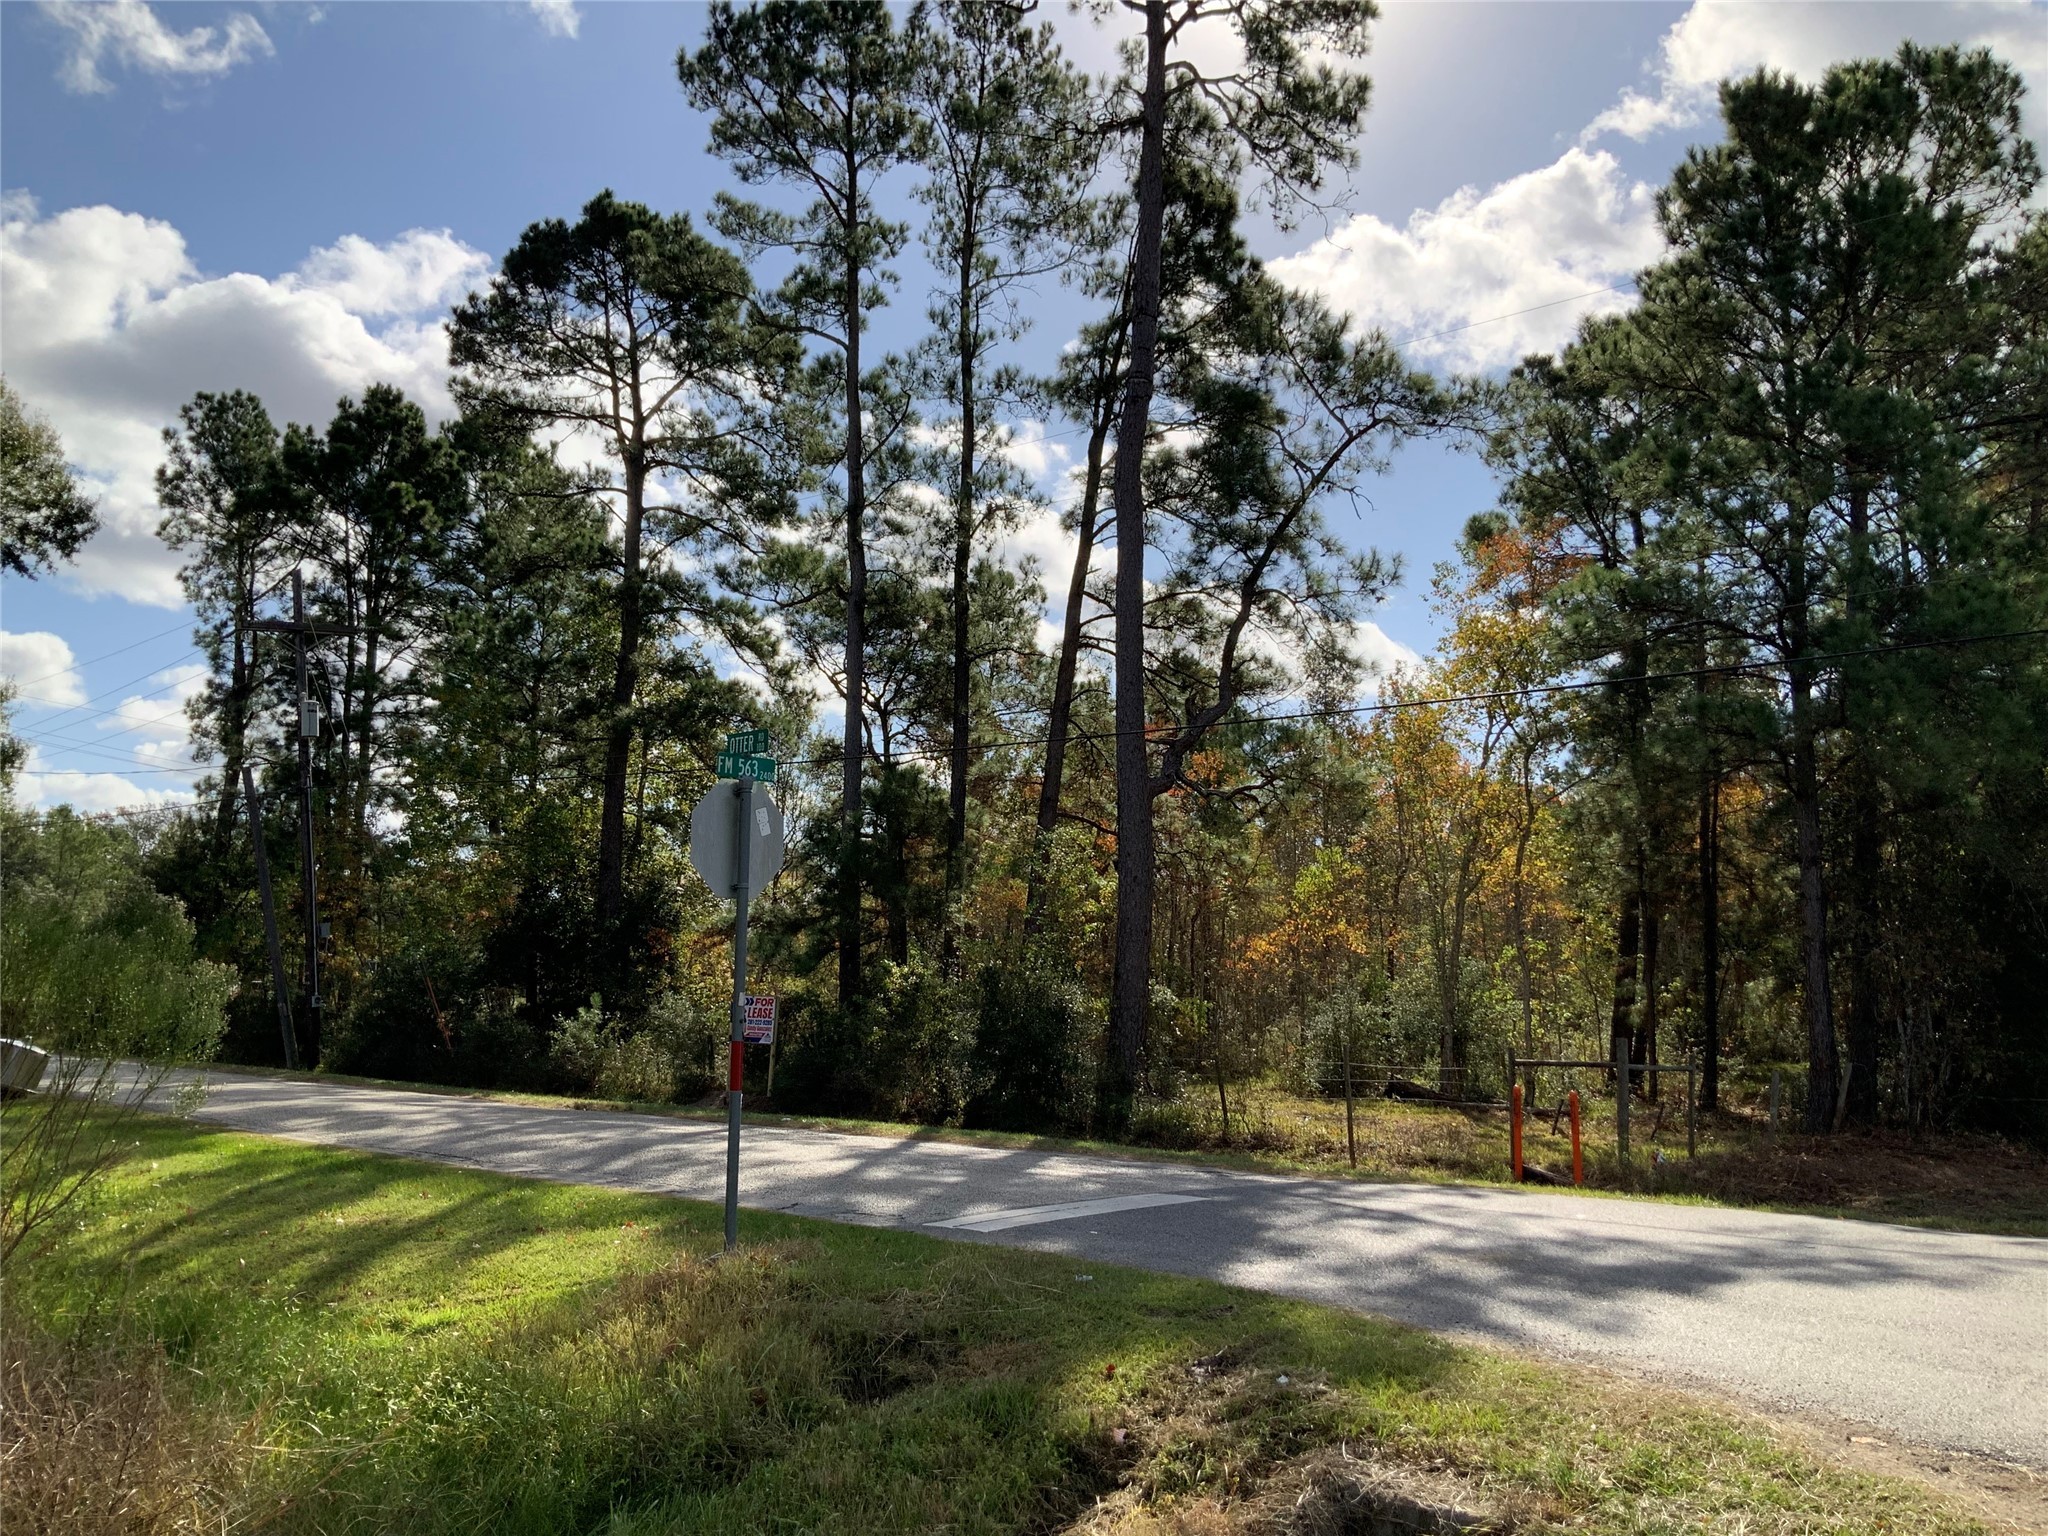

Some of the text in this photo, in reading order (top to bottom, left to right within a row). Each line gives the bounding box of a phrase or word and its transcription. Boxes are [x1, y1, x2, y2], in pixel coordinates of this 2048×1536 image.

[730, 735, 754, 754] OTTER
[718, 756, 733, 774] FM
[739, 759, 758, 777] 563
[755, 998, 774, 1006] FOR
[748, 1007, 773, 1019] LEASE
